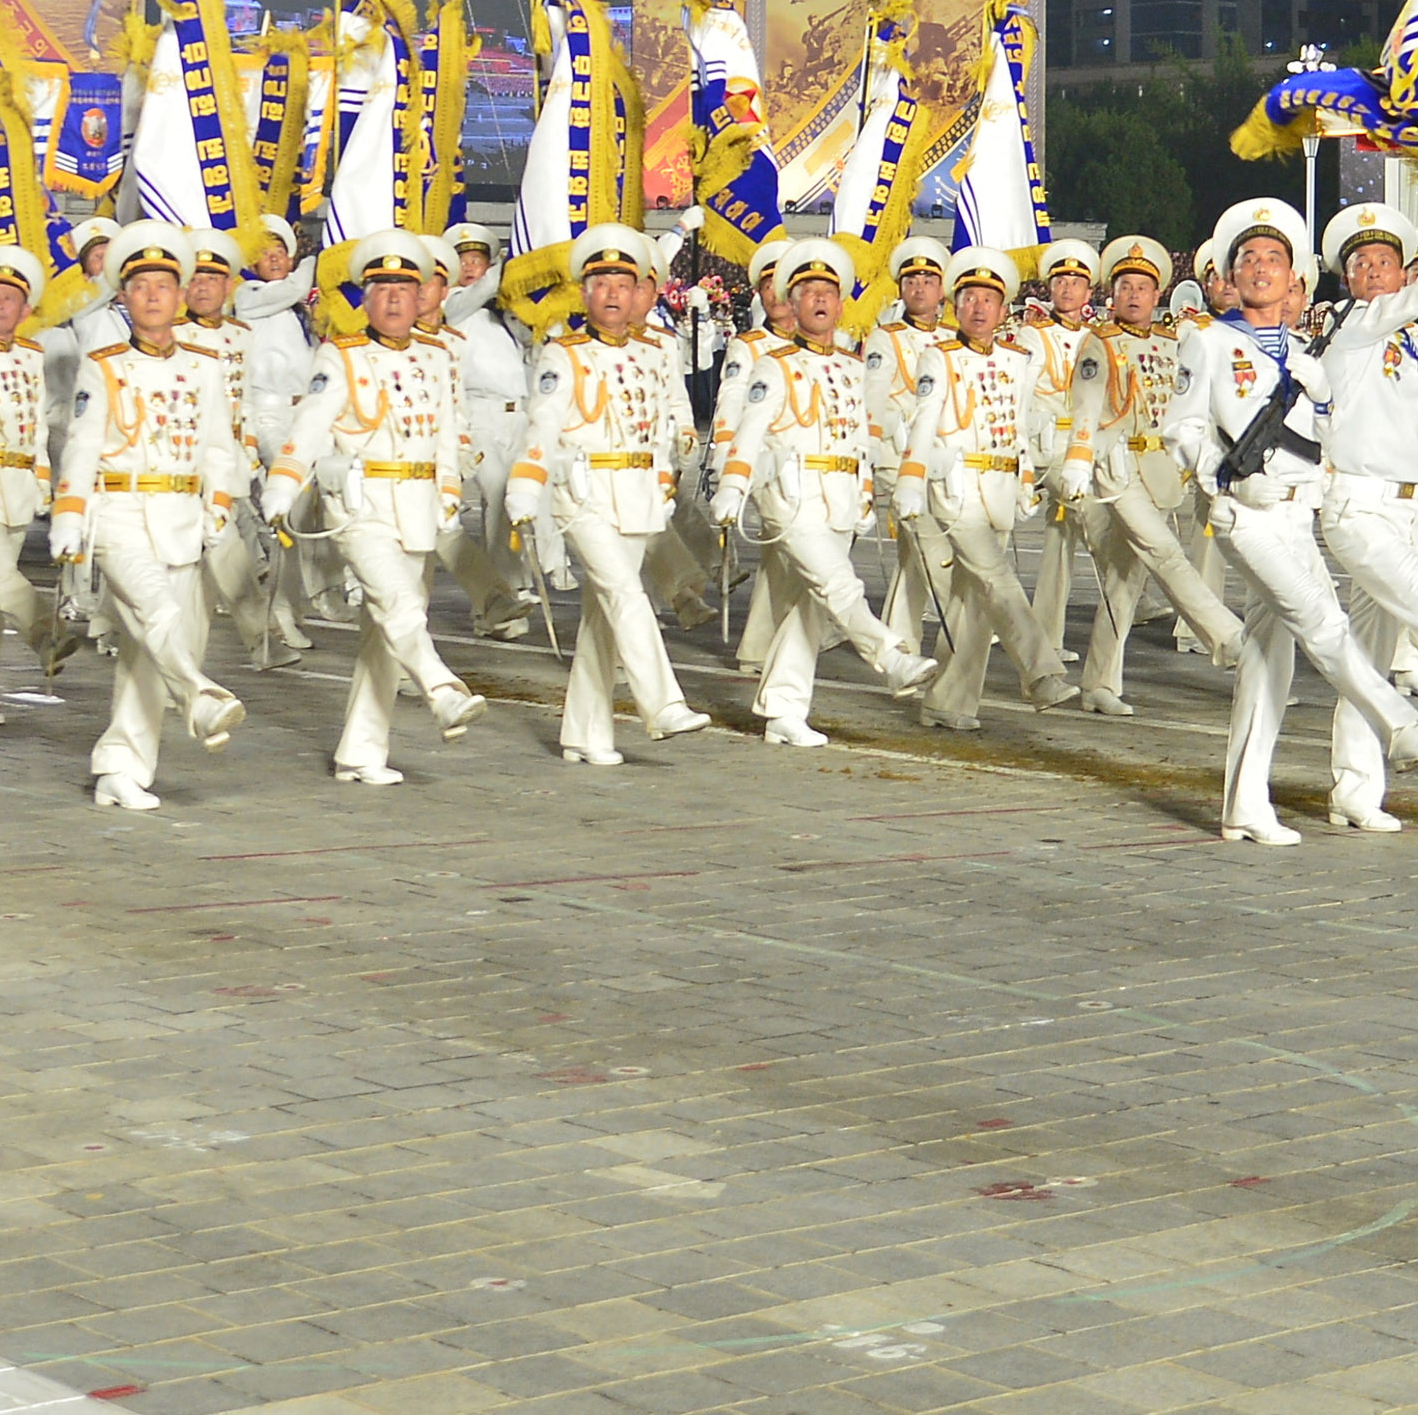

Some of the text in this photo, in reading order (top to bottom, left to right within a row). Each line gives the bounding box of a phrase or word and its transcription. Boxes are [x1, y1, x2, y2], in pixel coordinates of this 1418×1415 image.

[181, 41, 217, 118] 무궁한
[569, 54, 591, 129] 무궁한
[196, 137, 234, 216] 번영과
[567, 149, 590, 223] 번영과
